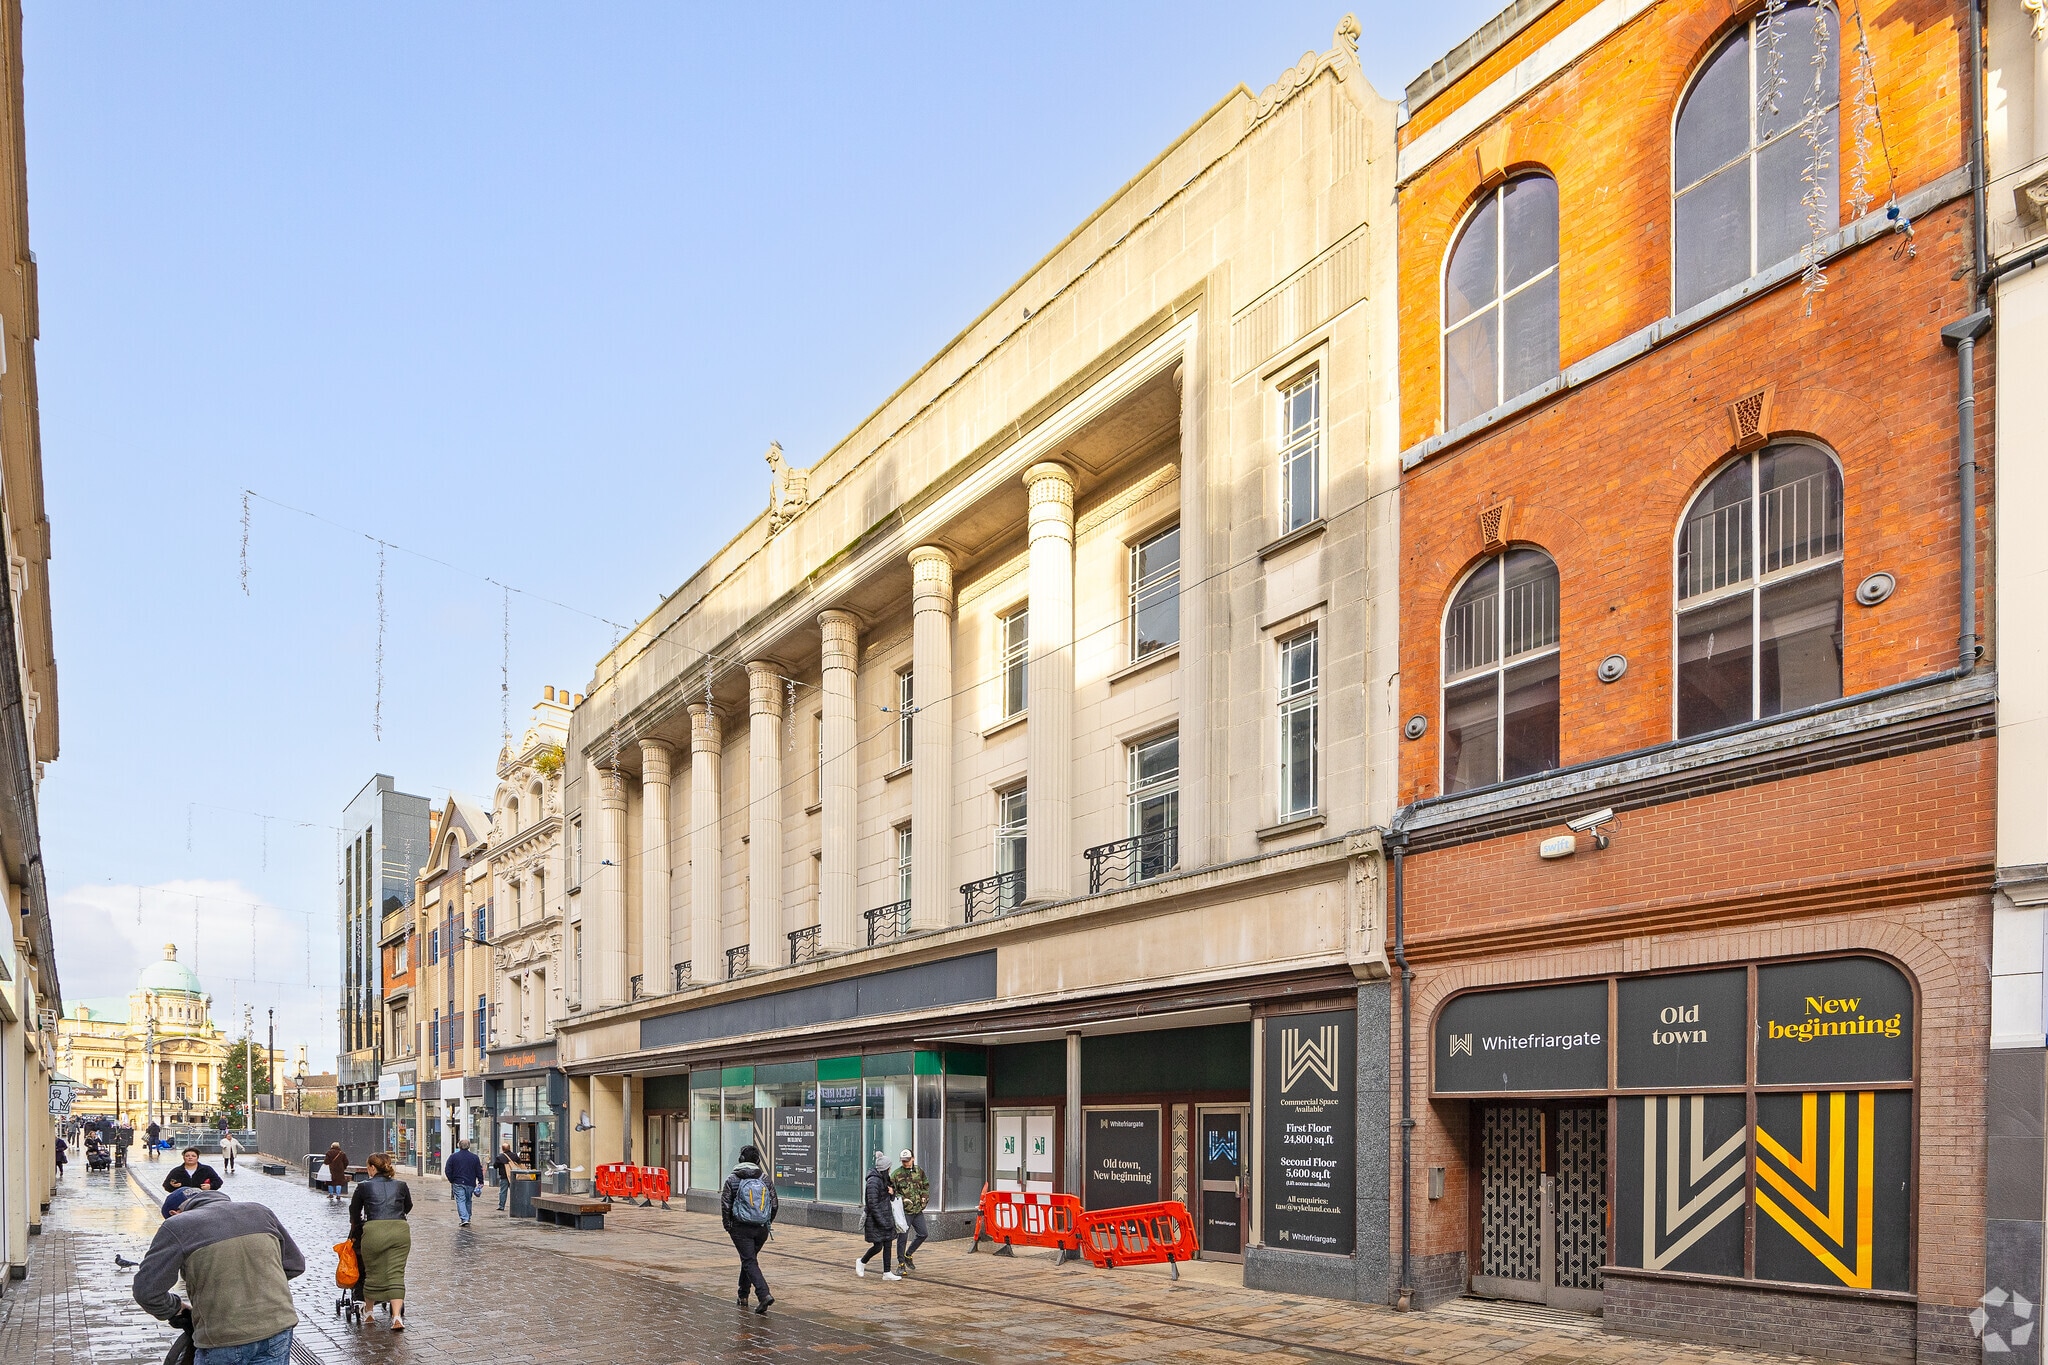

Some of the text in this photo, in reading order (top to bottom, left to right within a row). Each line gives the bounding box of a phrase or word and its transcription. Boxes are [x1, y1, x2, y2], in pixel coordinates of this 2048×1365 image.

[1544, 838, 1569, 852] swift
[1804, 995, 1861, 1016] New
[1660, 1004, 1700, 1024] Old
[1768, 1014, 1902, 1042] beginning
[1482, 1030, 1601, 1051] Whitefriargate
[1652, 1026, 1708, 1046] town
[502, 1054, 522, 1070] Sterling
[1280, 1098, 1339, 1106] Commercial Space
[1294, 1105, 1324, 1113] Available
[786, 1116, 804, 1124] TO LET
[1110, 1120, 1144, 1128] Whitefriargate
[1286, 1123, 1332, 1133] First Floor
[1283, 1134, 1334, 1146] 24,800 sq.ft
[1103, 1158, 1141, 1170] Old town,
[1280, 1158, 1337, 1168] Second Floor
[1094, 1170, 1152, 1184] New beginning
[1286, 1169, 1331, 1181] 5,600 sq.ft
[1296, 1196, 1329, 1206] enquiries:
[1275, 1203, 1341, 1214] taw@wykeland.co.uk
[1292, 1232, 1337, 1244] Whitefriargate
